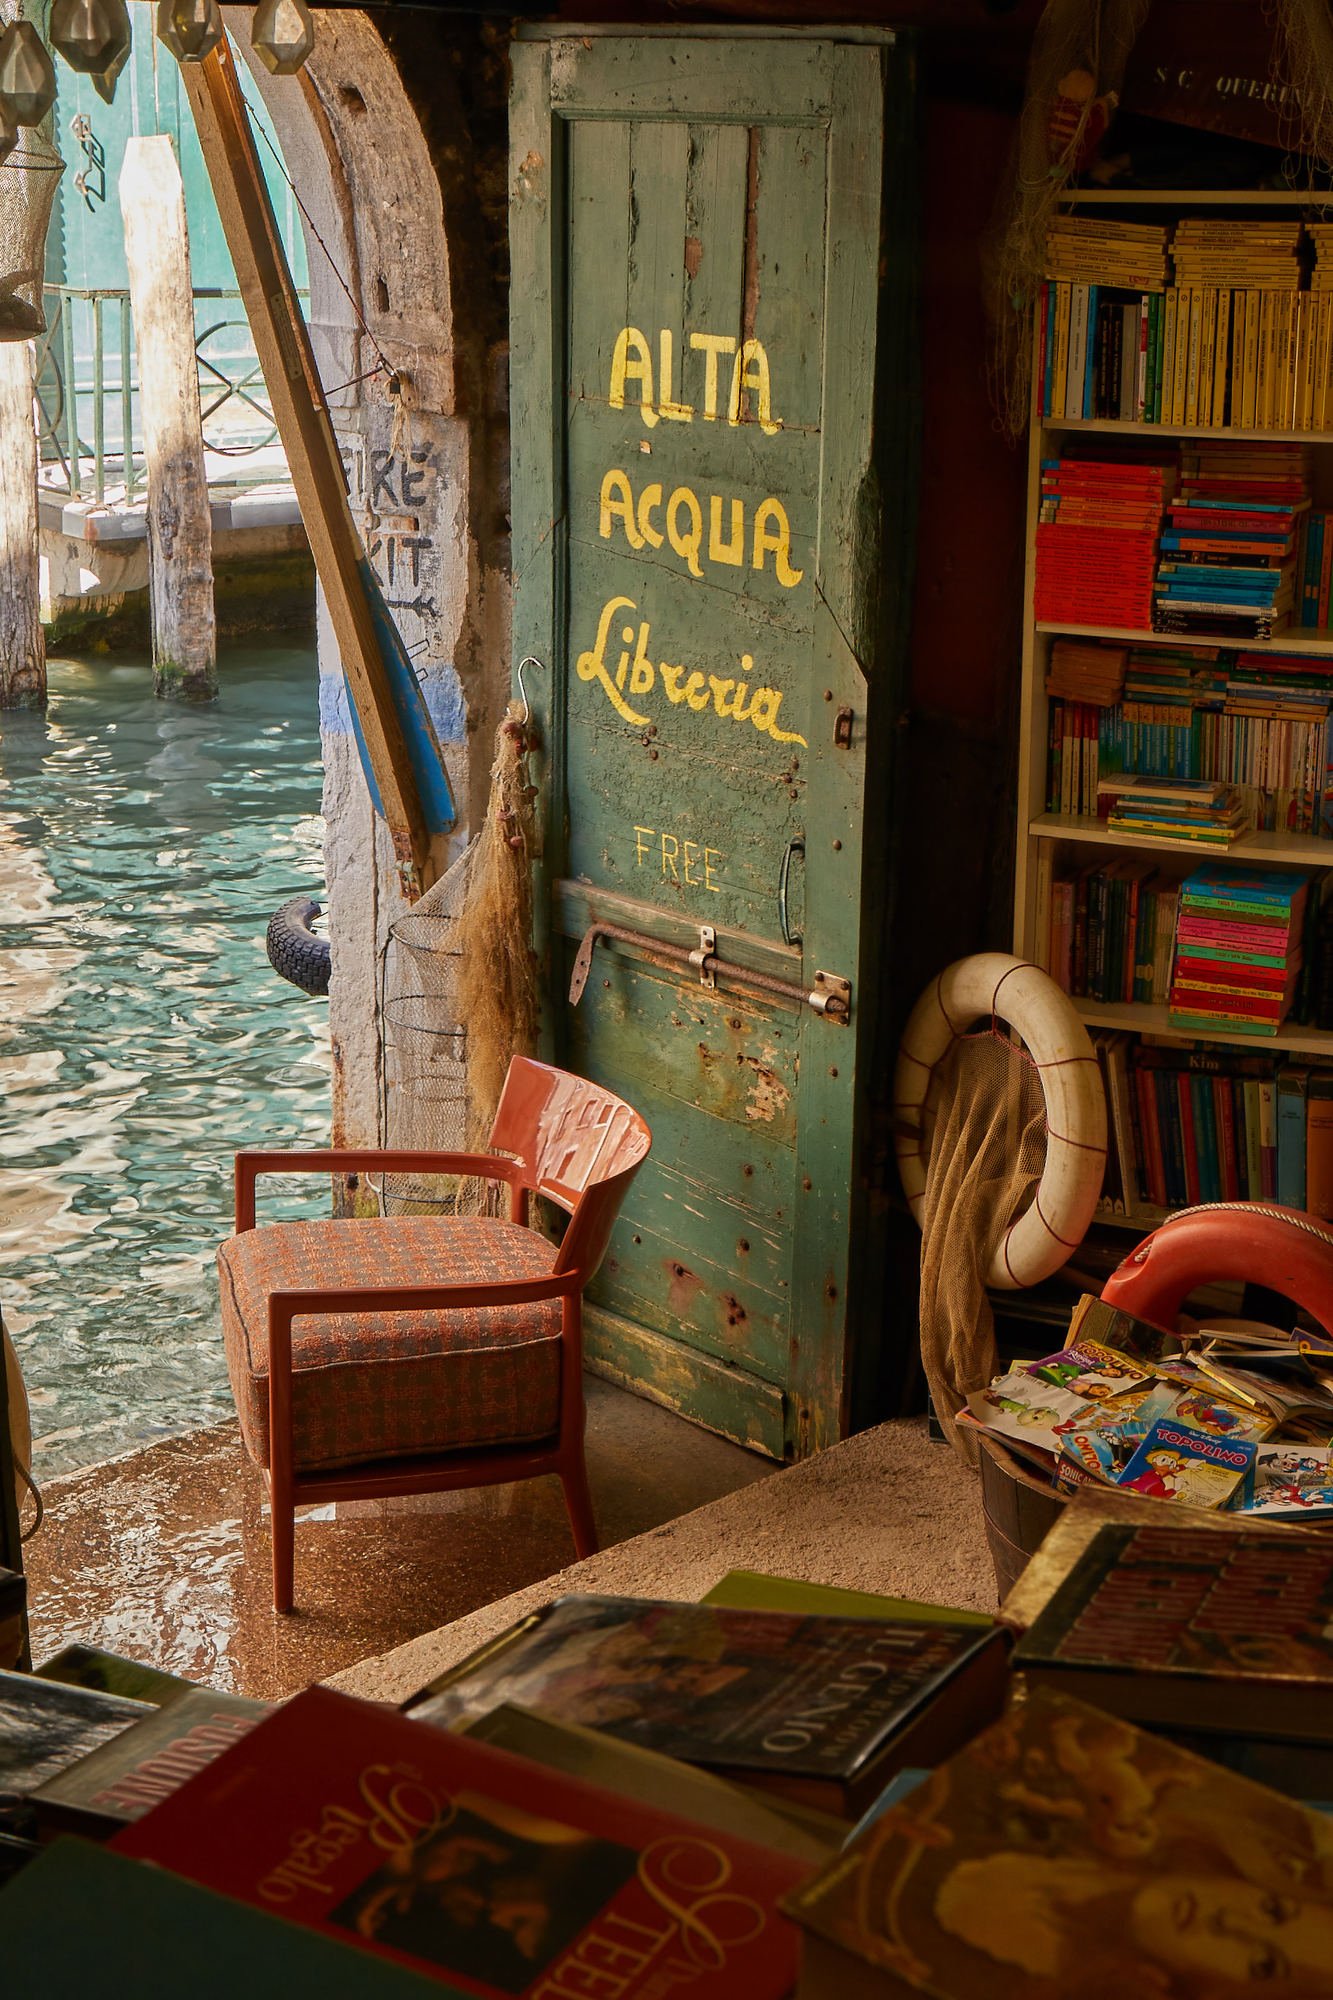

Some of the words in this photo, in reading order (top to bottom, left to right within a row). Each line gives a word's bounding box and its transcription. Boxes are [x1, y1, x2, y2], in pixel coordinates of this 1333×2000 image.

[609, 326, 784, 436] ALTA
[599, 469, 803, 588] ACQUA
[576, 596, 808, 748] Libreria
[633, 825, 722, 892] FREE
[1189, 1053, 1219, 1071] Kim
[1059, 1463, 1083, 1482] SONIC
[1156, 1428, 1248, 1466] TOPOLINO
[865, 1629, 927, 1655] IL
[761, 1661, 888, 1753] GENIO
[256, 1763, 459, 1904] Regalo
